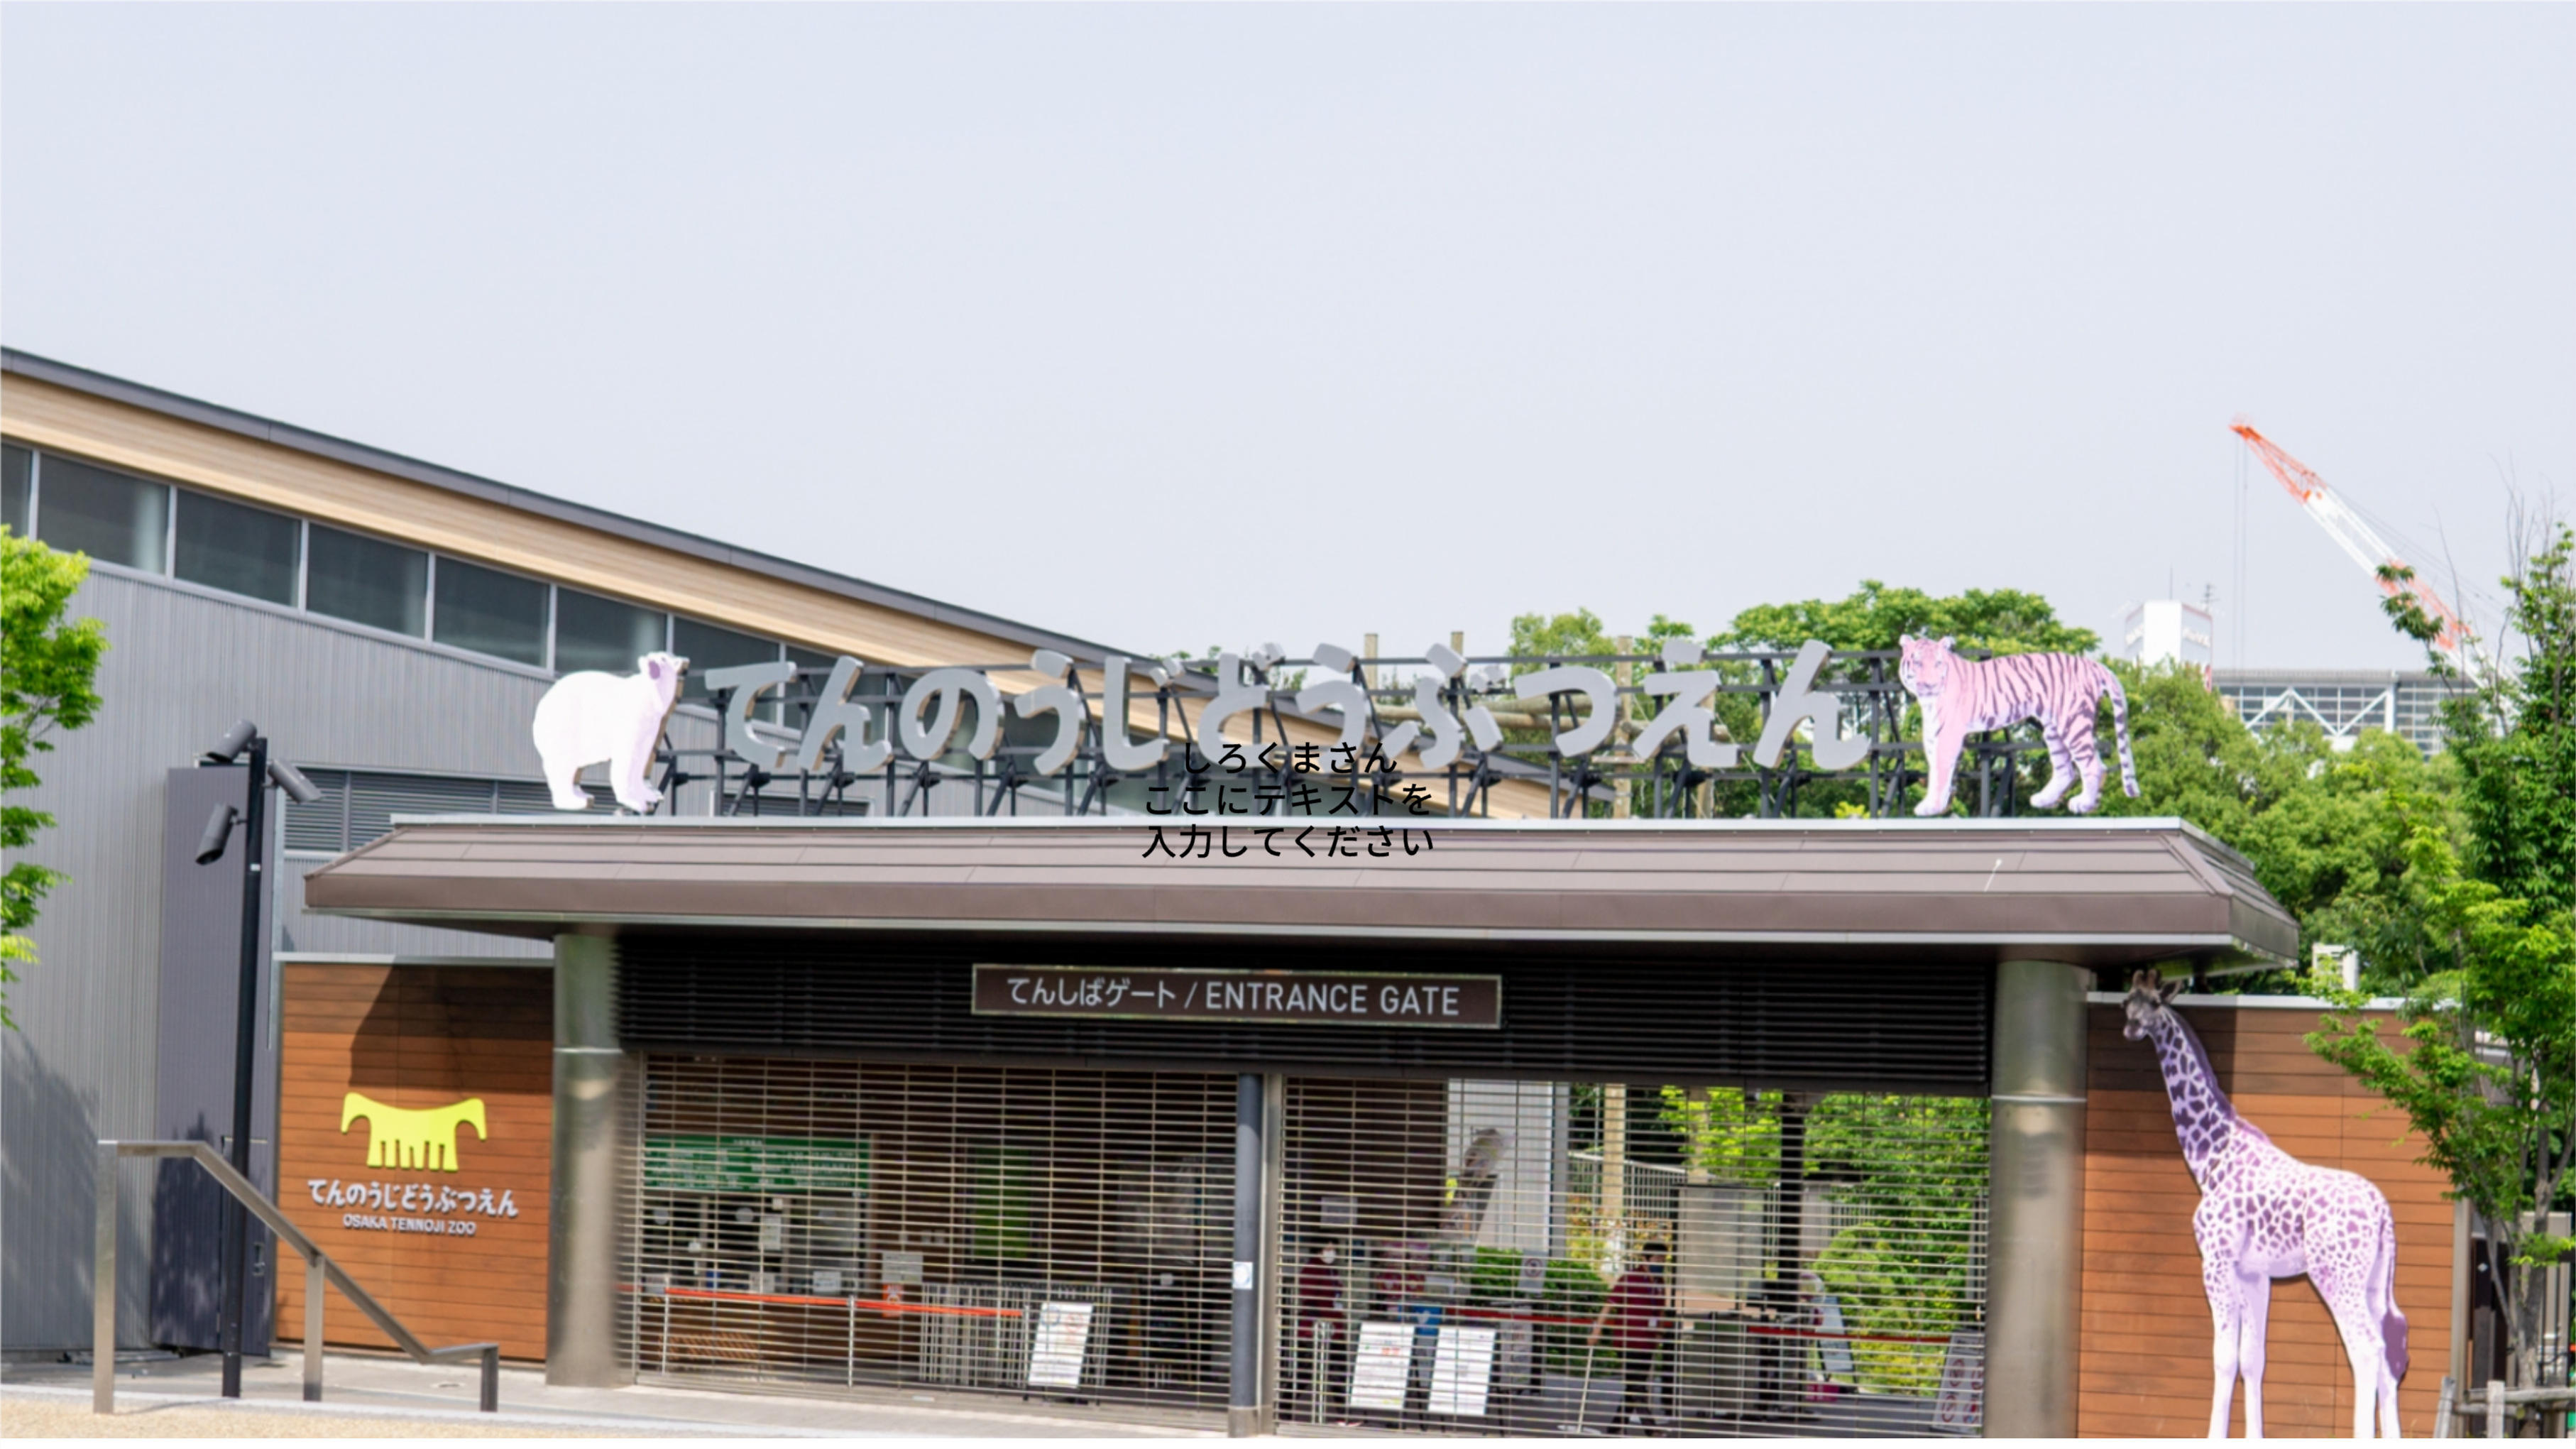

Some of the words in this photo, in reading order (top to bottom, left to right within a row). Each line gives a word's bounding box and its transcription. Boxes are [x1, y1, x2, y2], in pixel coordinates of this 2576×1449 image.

[705, 639, 1872, 776] てんのうじどうぶつえん
[1006, 977, 1176, 1010] てんしばゲート
[1206, 980, 1368, 1014] ENTRANCE
[1379, 985, 1459, 1016] GATE
[307, 1179, 519, 1218] てんのうじどうぶつえん
[343, 1213, 388, 1232] OSAKA
[391, 1217, 444, 1234] TENNOJI
[448, 1220, 477, 1237] ZOO
